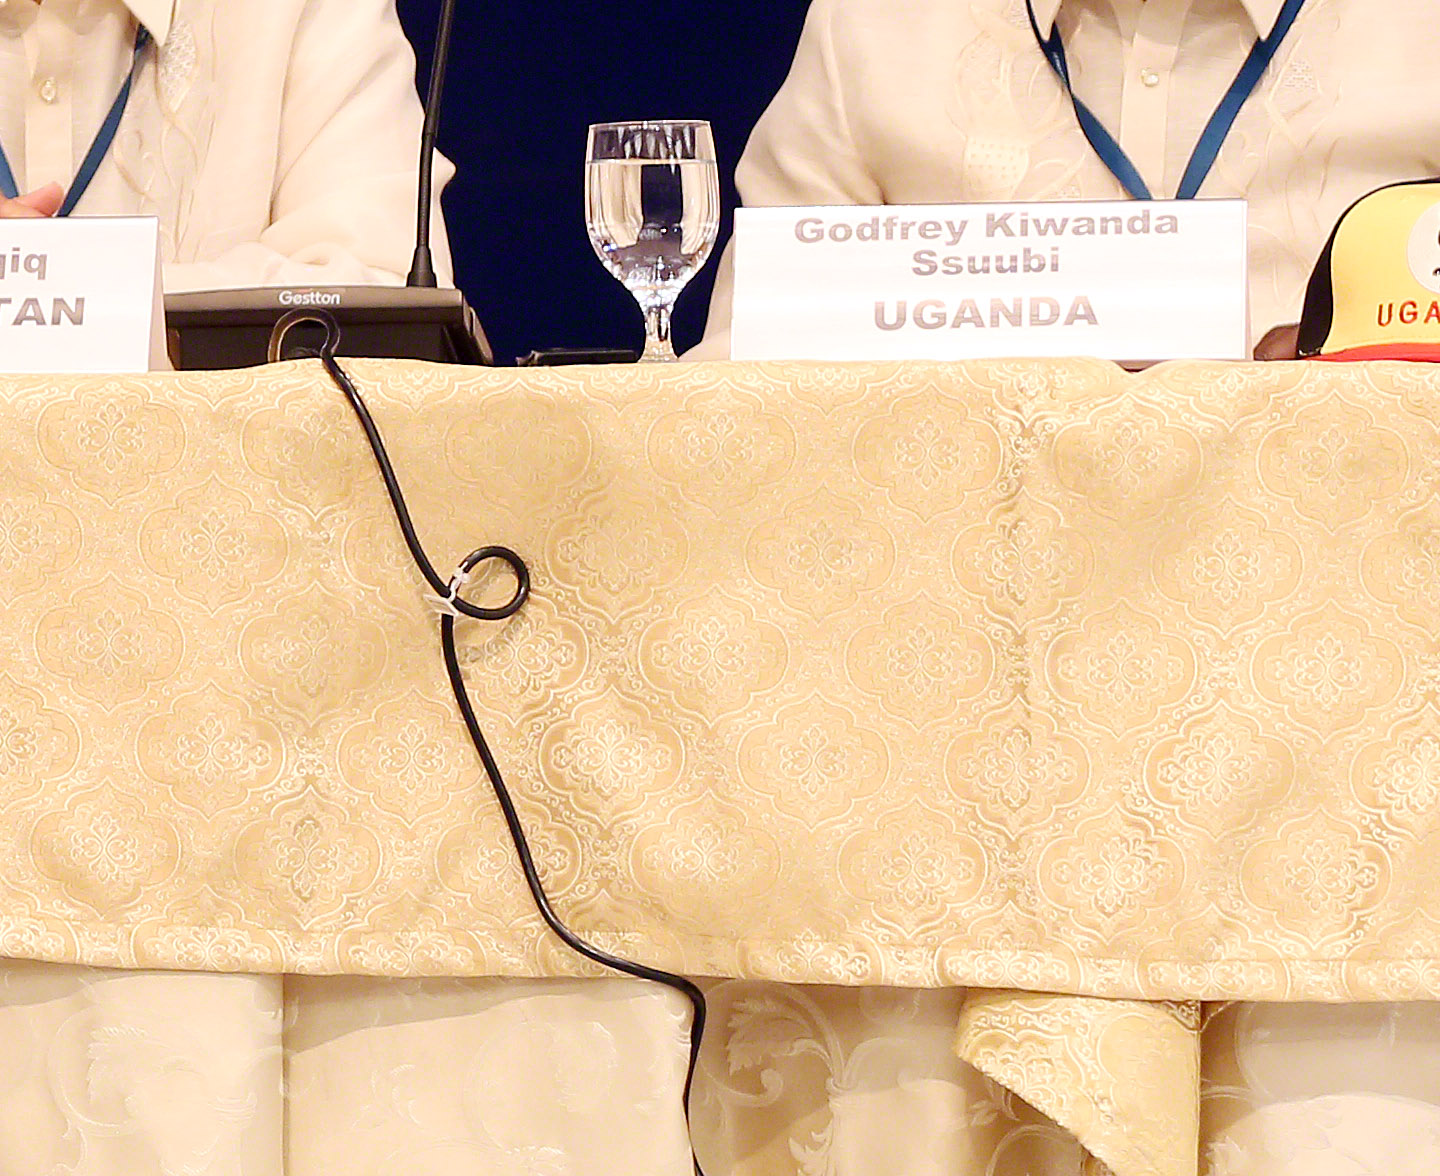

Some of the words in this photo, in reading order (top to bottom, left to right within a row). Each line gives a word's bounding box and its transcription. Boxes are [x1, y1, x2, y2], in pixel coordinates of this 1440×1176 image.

[794, 212, 968, 246] Godfrey
[985, 208, 1179, 239] Kiwanda
[911, 246, 1060, 277] Ssuubi
[873, 295, 1098, 332] UGANDA
